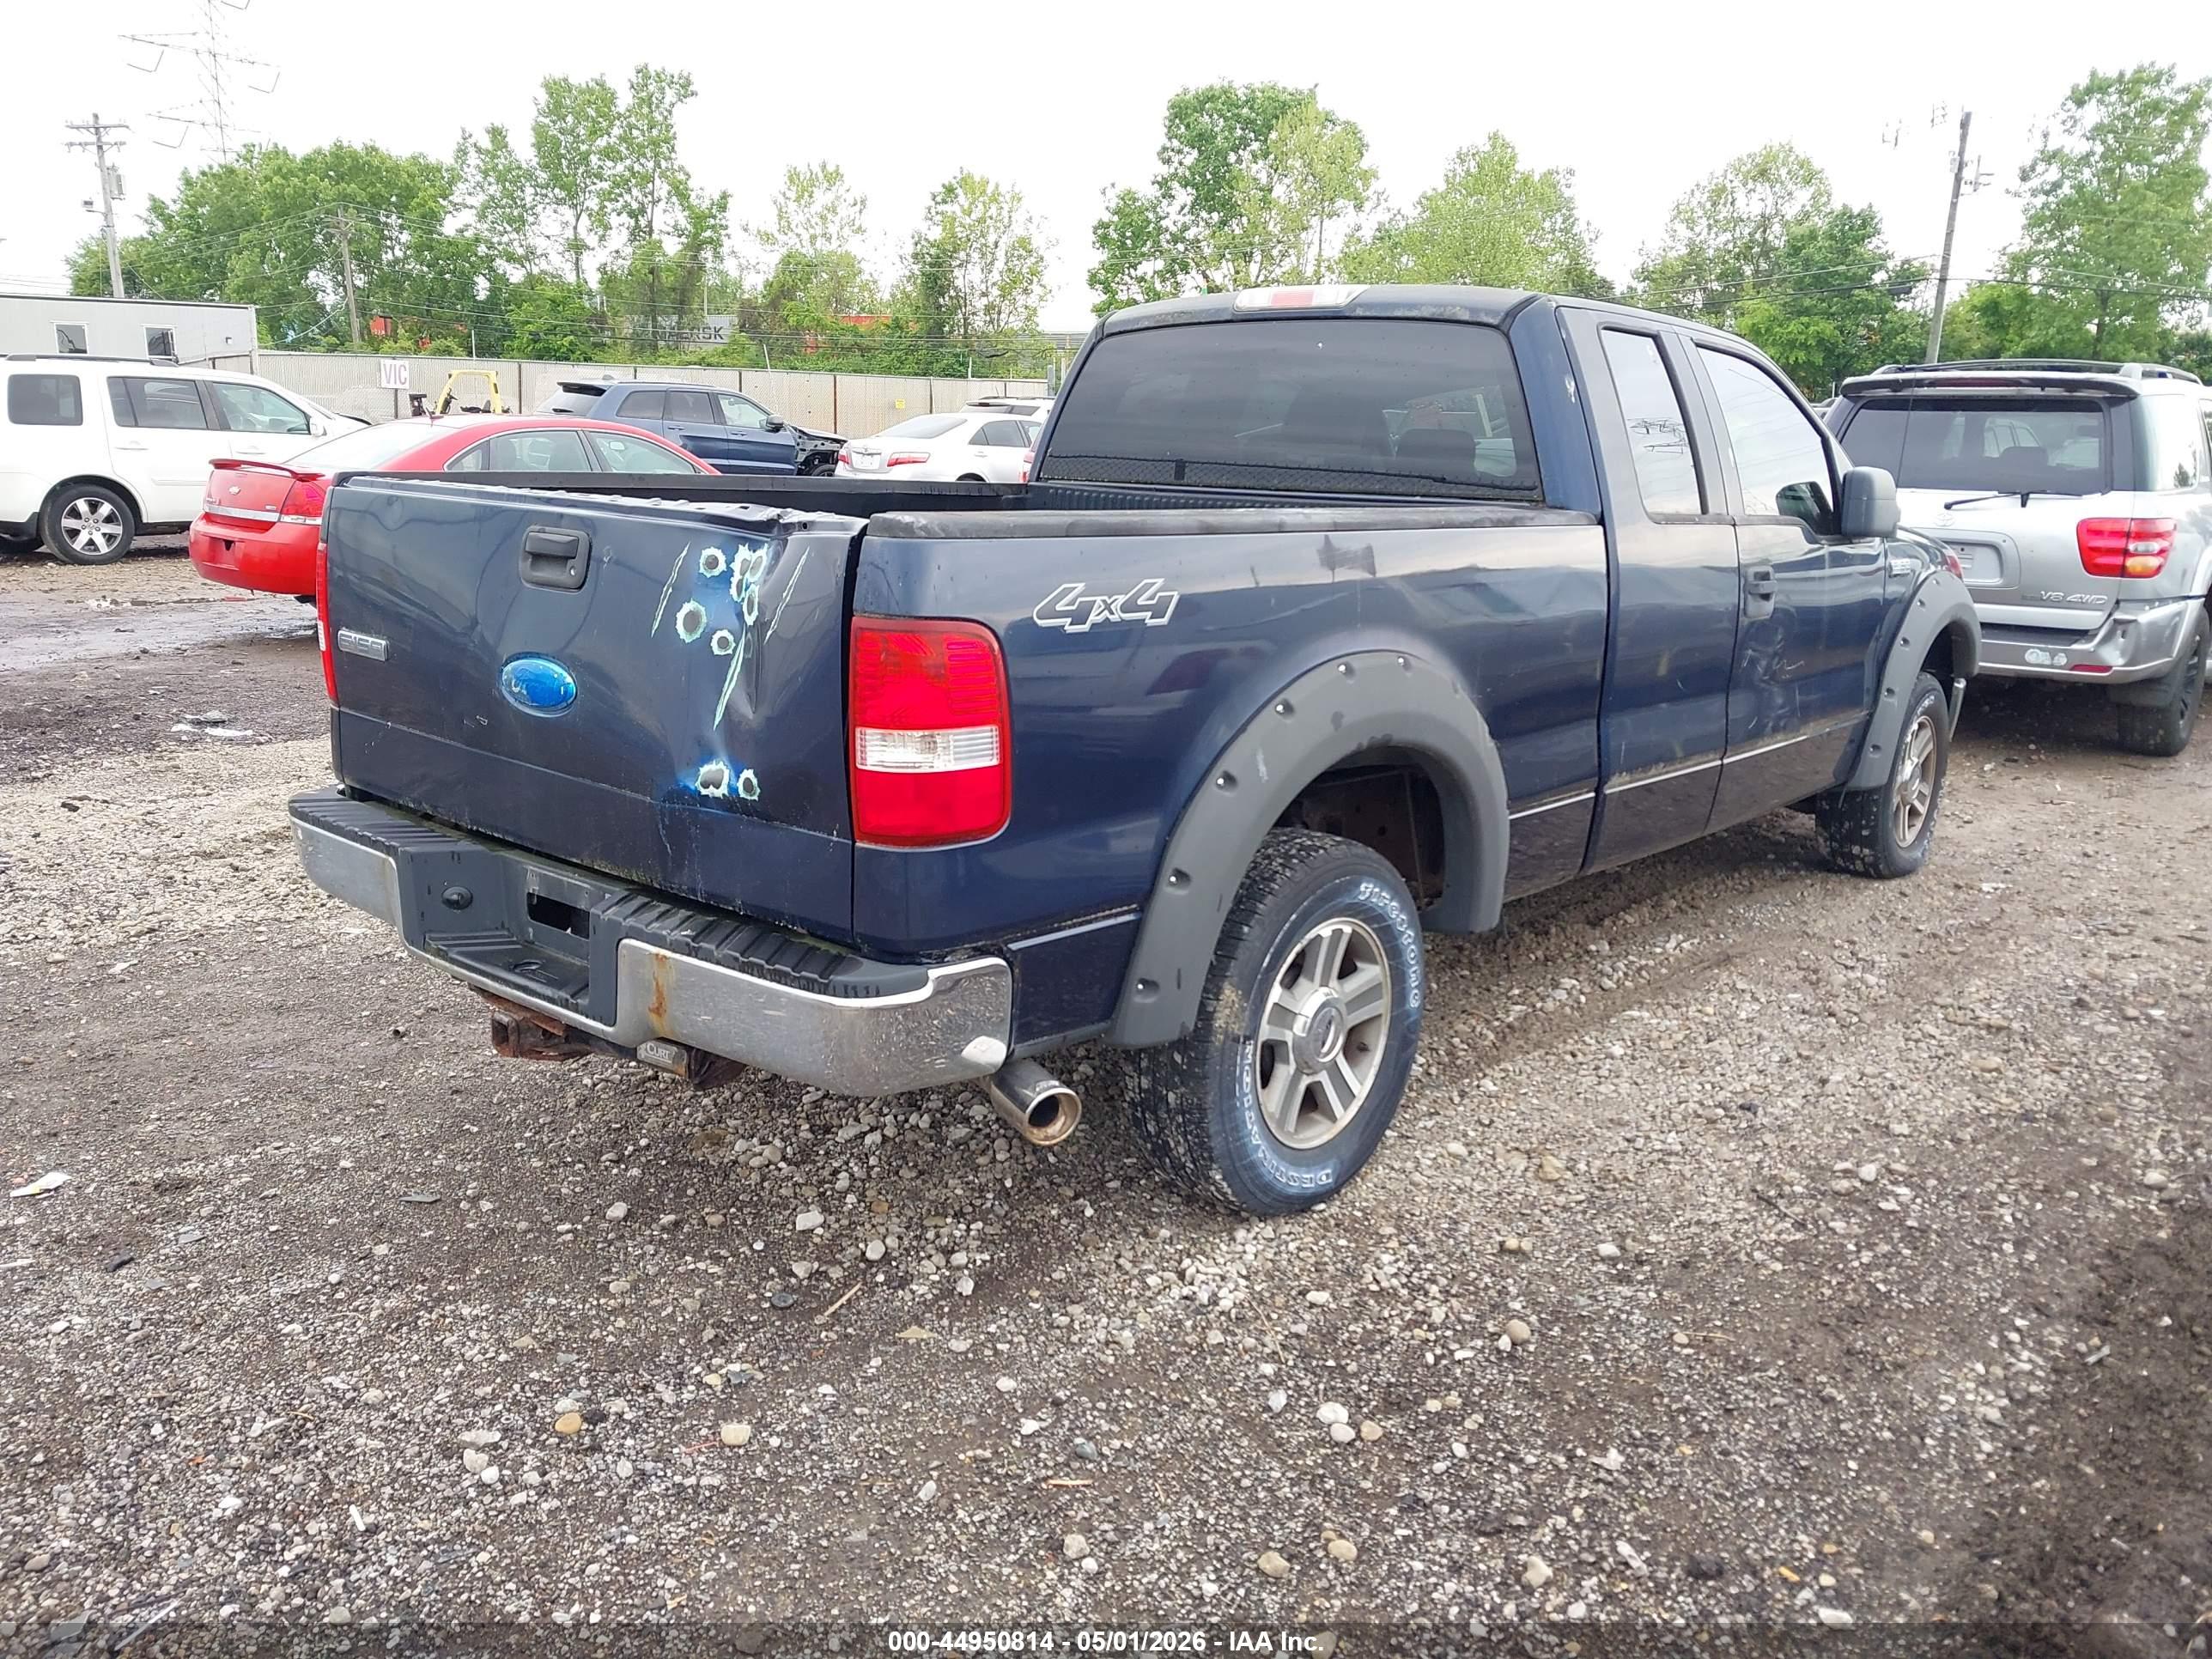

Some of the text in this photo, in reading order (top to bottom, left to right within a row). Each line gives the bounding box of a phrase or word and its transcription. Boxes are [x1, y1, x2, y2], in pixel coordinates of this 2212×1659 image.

[383, 362, 408, 386] VIC
[1032, 577, 1181, 634] 4x4
[2040, 591, 2109, 605] V8 4WD
[646, 1042, 671, 1060] CURT
